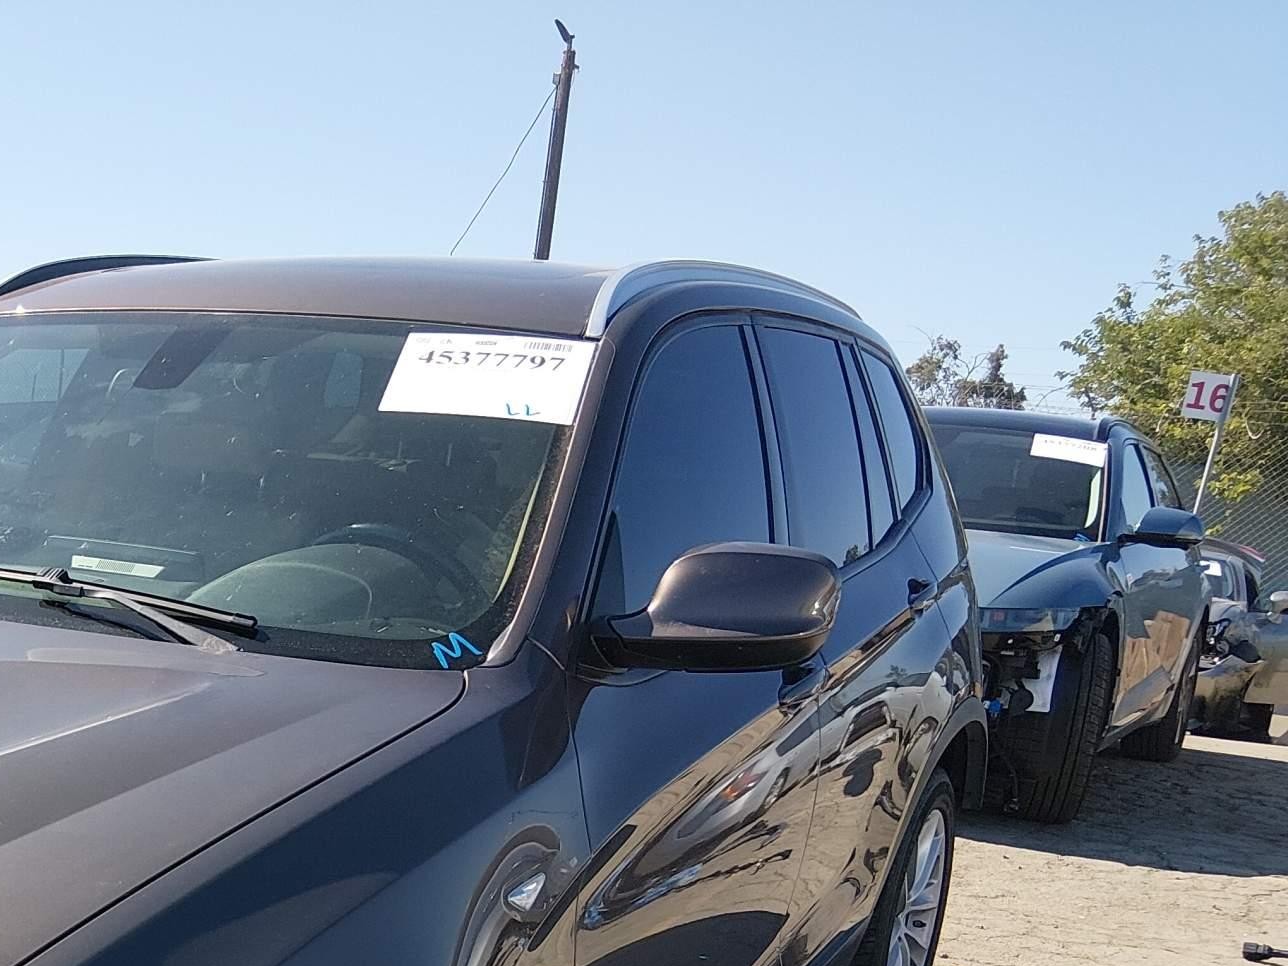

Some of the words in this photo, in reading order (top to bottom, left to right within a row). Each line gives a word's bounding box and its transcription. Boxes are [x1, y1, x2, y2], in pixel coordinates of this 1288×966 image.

[418, 350, 567, 372] 45377797
[1186, 381, 1230, 413] 16
[431, 632, 483, 669] M
